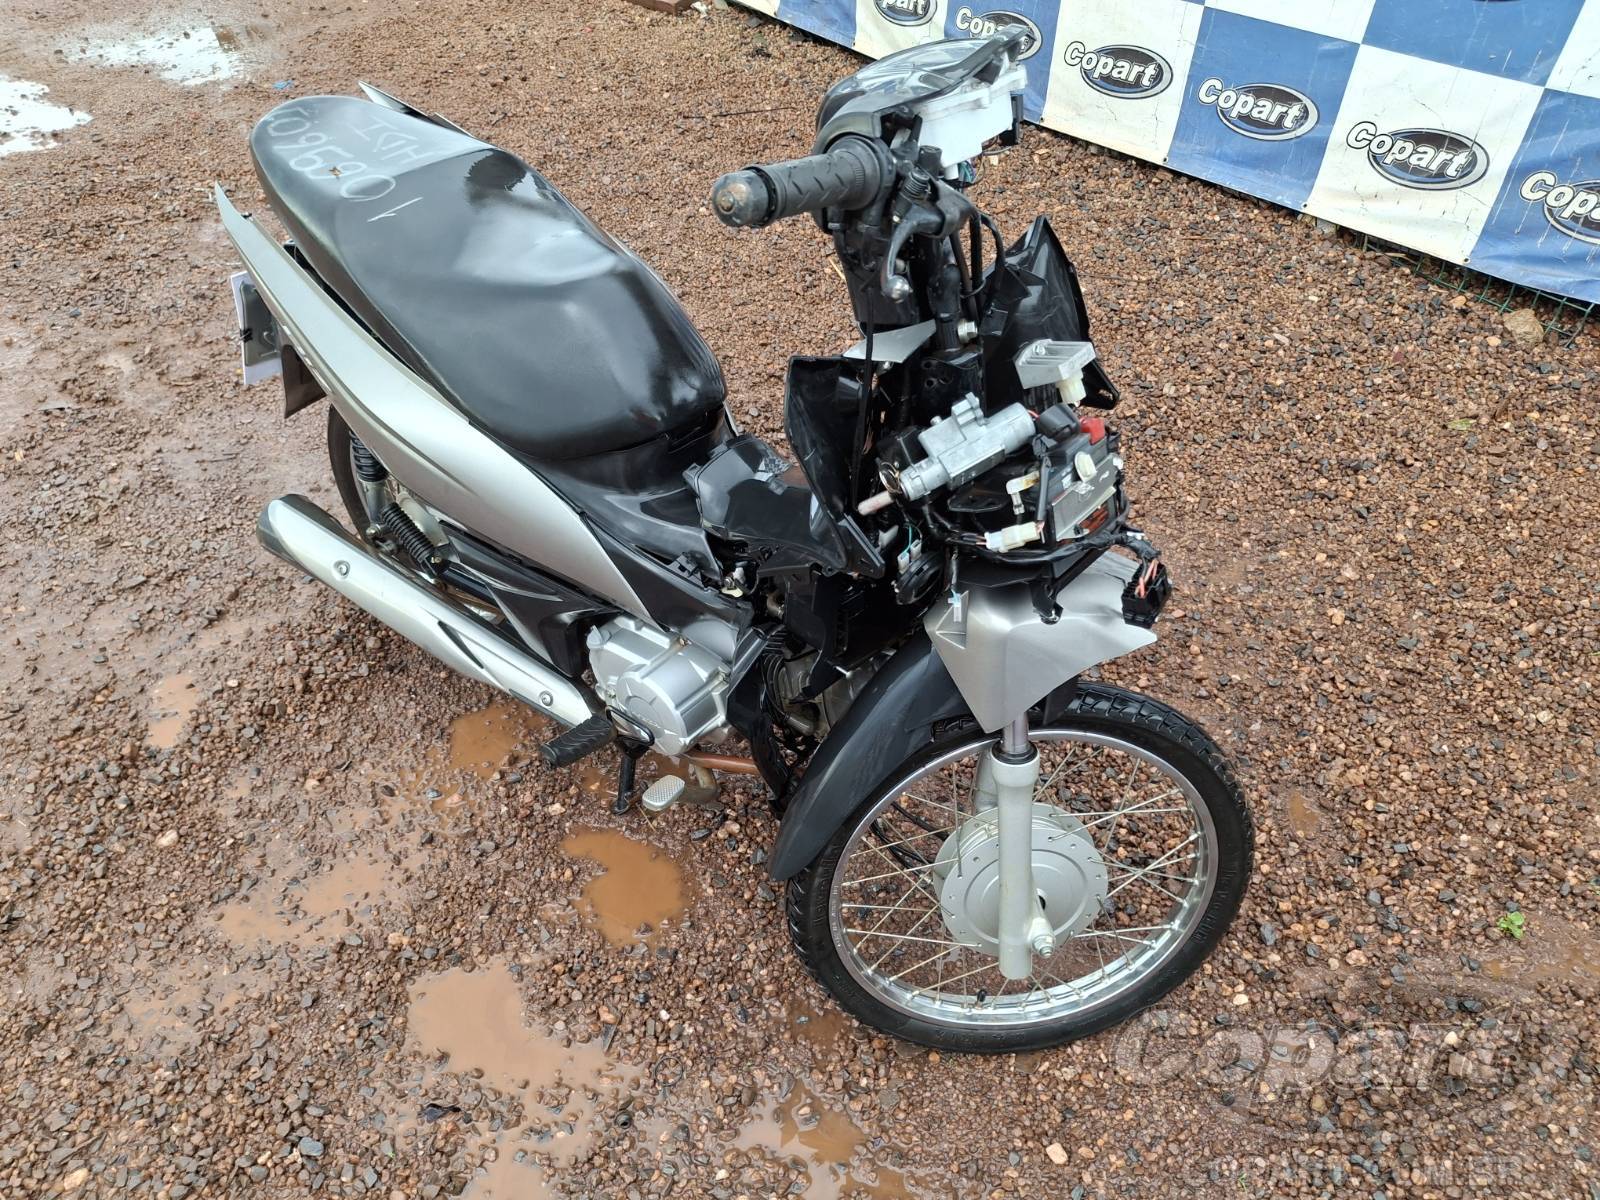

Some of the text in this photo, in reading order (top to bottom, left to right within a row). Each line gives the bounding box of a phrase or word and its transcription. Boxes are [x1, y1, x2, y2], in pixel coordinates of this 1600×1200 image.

[1064, 41, 1160, 87] Copart
[1198, 76, 1305, 130] Copart
[1346, 121, 1474, 179] Copart
